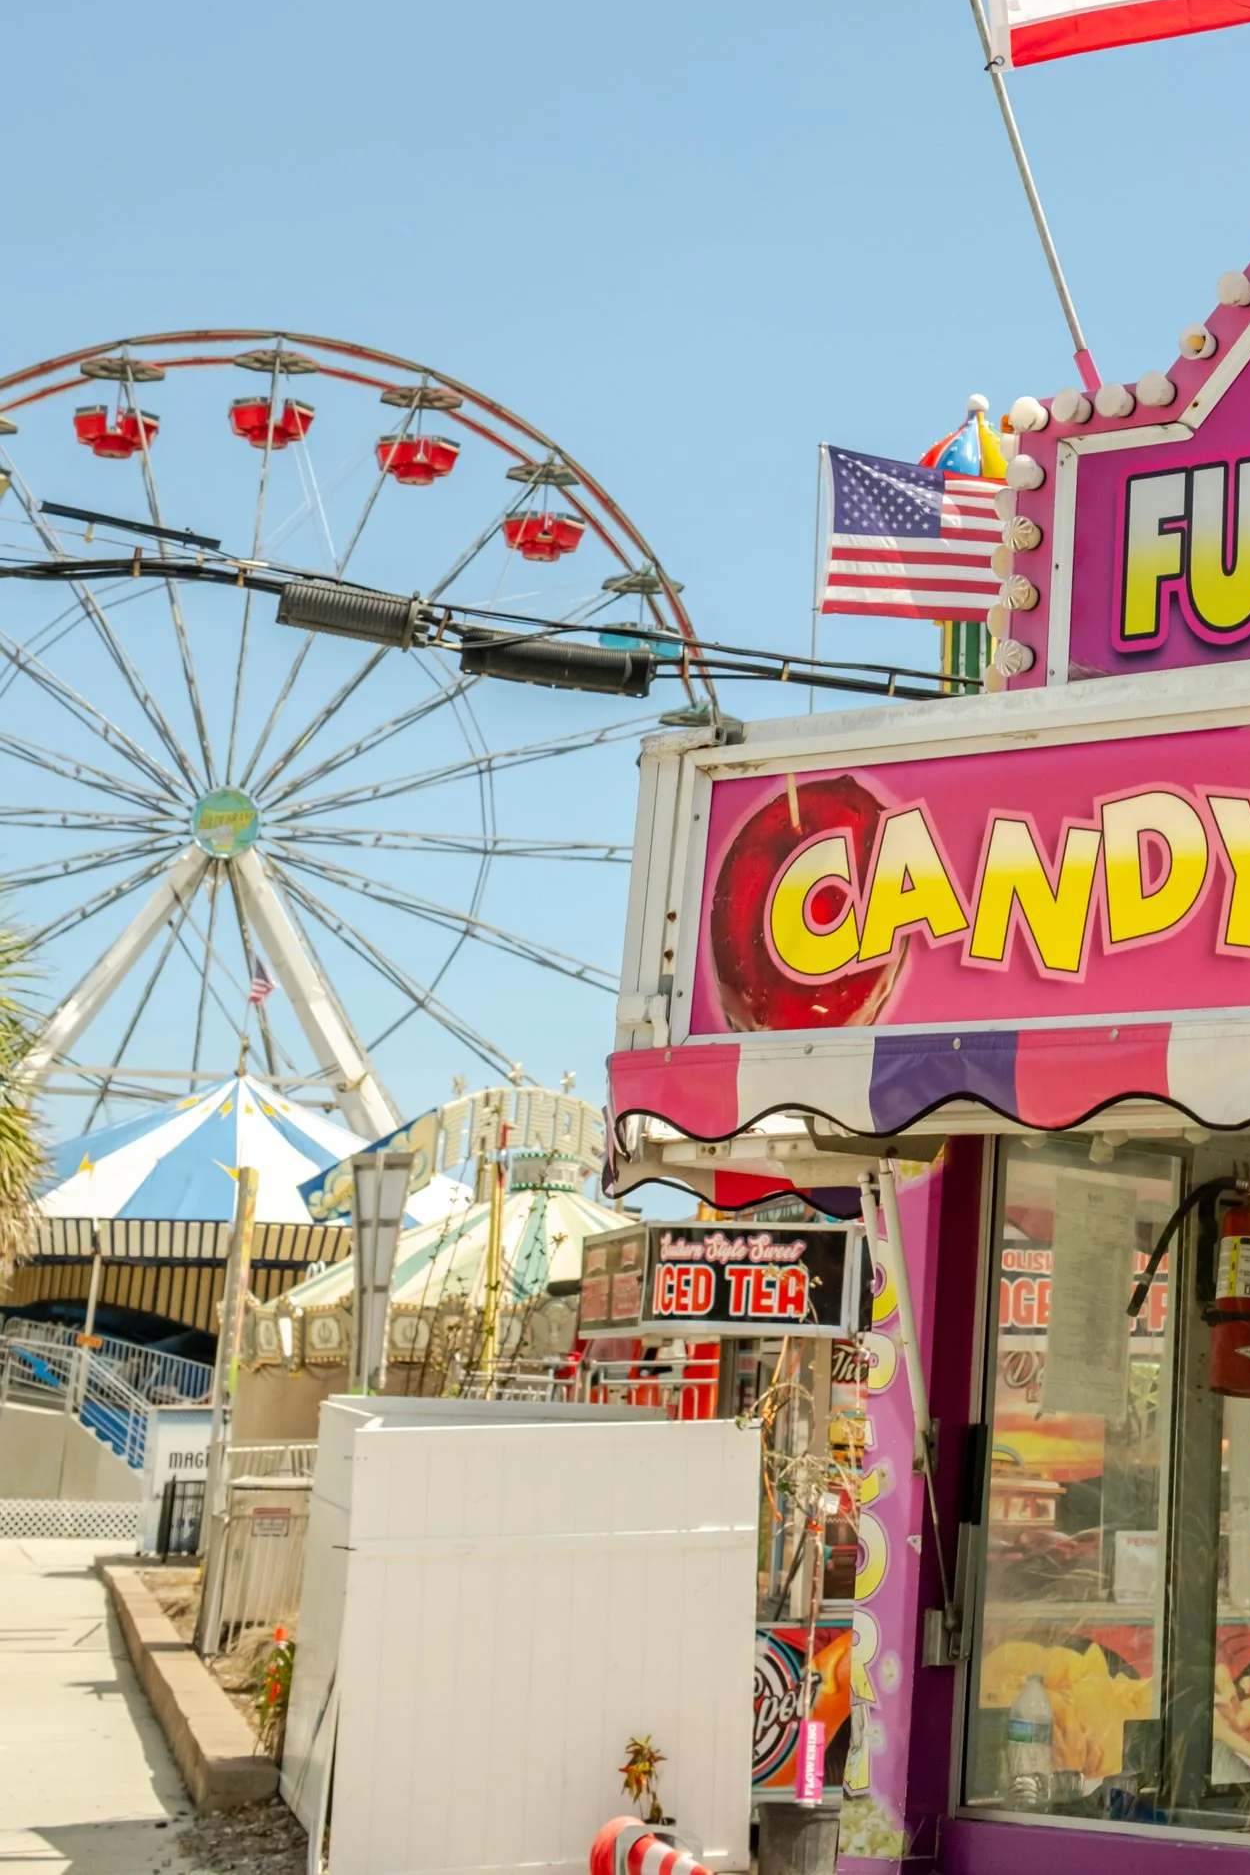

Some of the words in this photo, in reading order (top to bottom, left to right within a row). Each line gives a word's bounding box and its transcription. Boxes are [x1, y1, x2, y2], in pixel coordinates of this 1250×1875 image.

[704, 1231, 749, 1265] Style
[747, 1232, 808, 1262] Sweet
[652, 1263, 715, 1315] ICED
[725, 1263, 809, 1317] TEA
[169, 1451, 210, 1469] MAGI
[804, 1722, 817, 1797] FLOWERING
